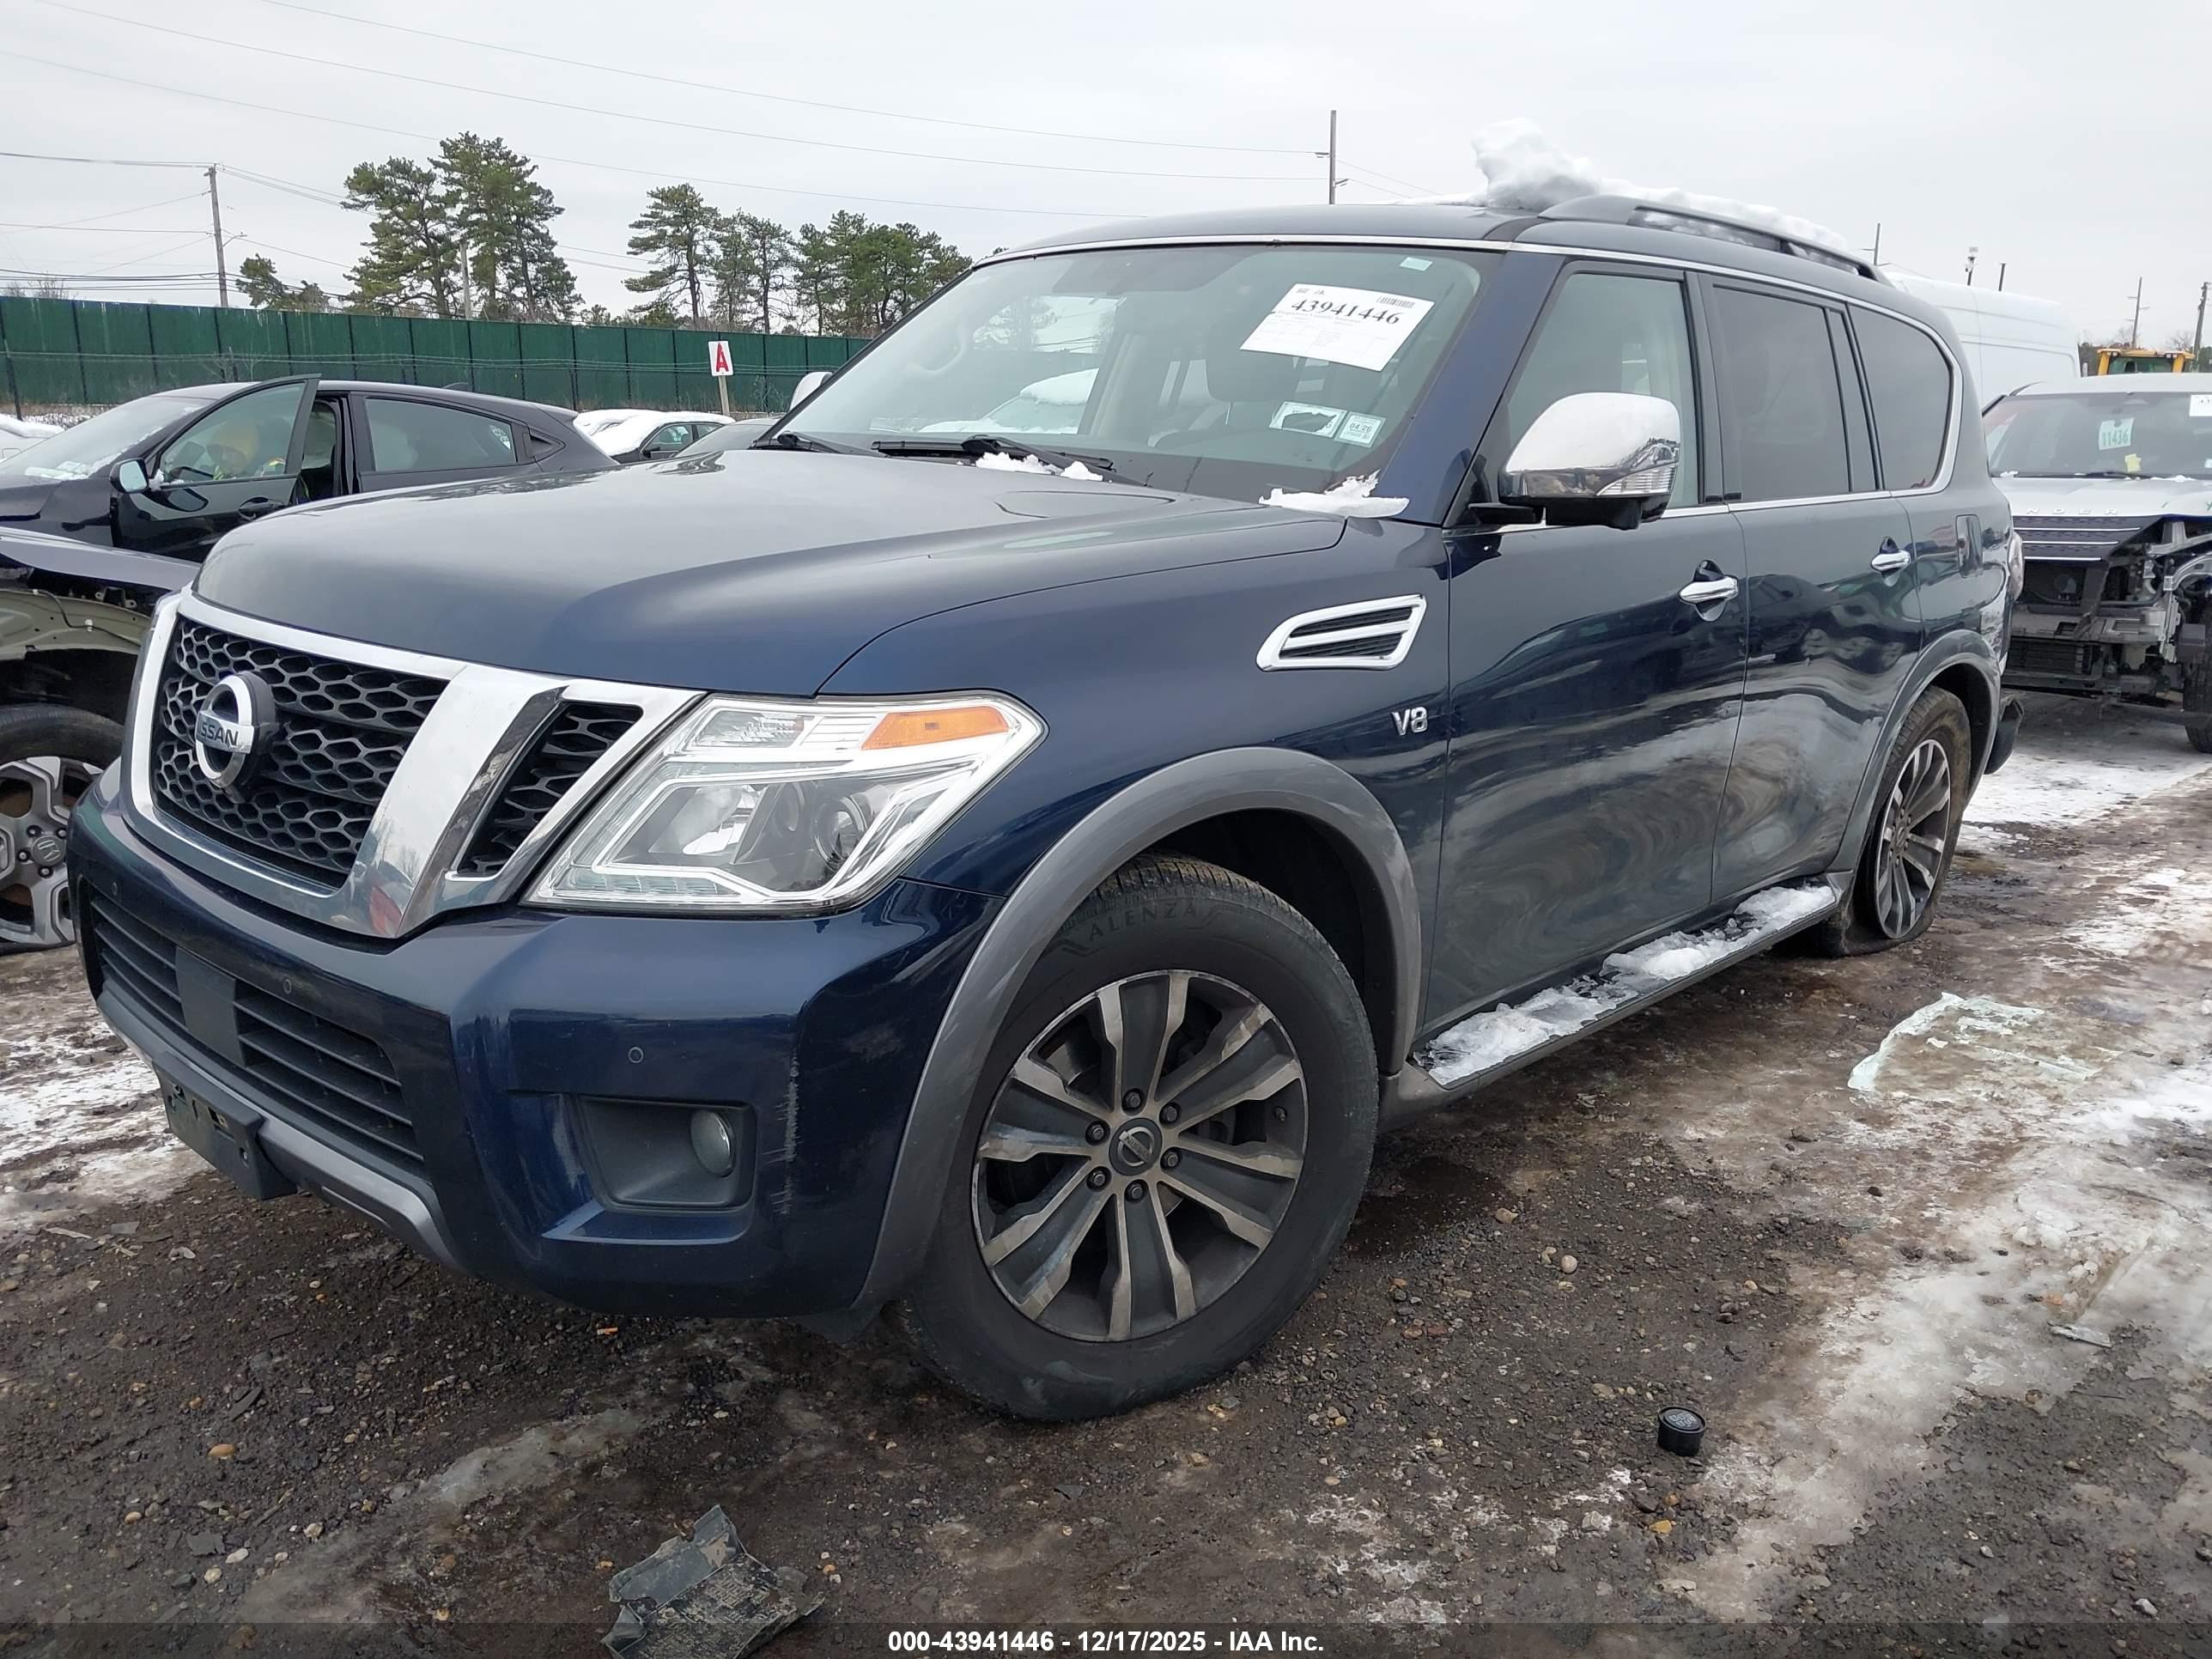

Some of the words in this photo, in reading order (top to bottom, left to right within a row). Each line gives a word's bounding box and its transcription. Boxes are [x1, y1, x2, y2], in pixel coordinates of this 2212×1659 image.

[1291, 298, 1406, 325] 43941446
[715, 343, 729, 373] A
[198, 721, 239, 746] SSAN
[1390, 706, 1428, 736] V8
[1089, 902, 1198, 941] ALENZA
